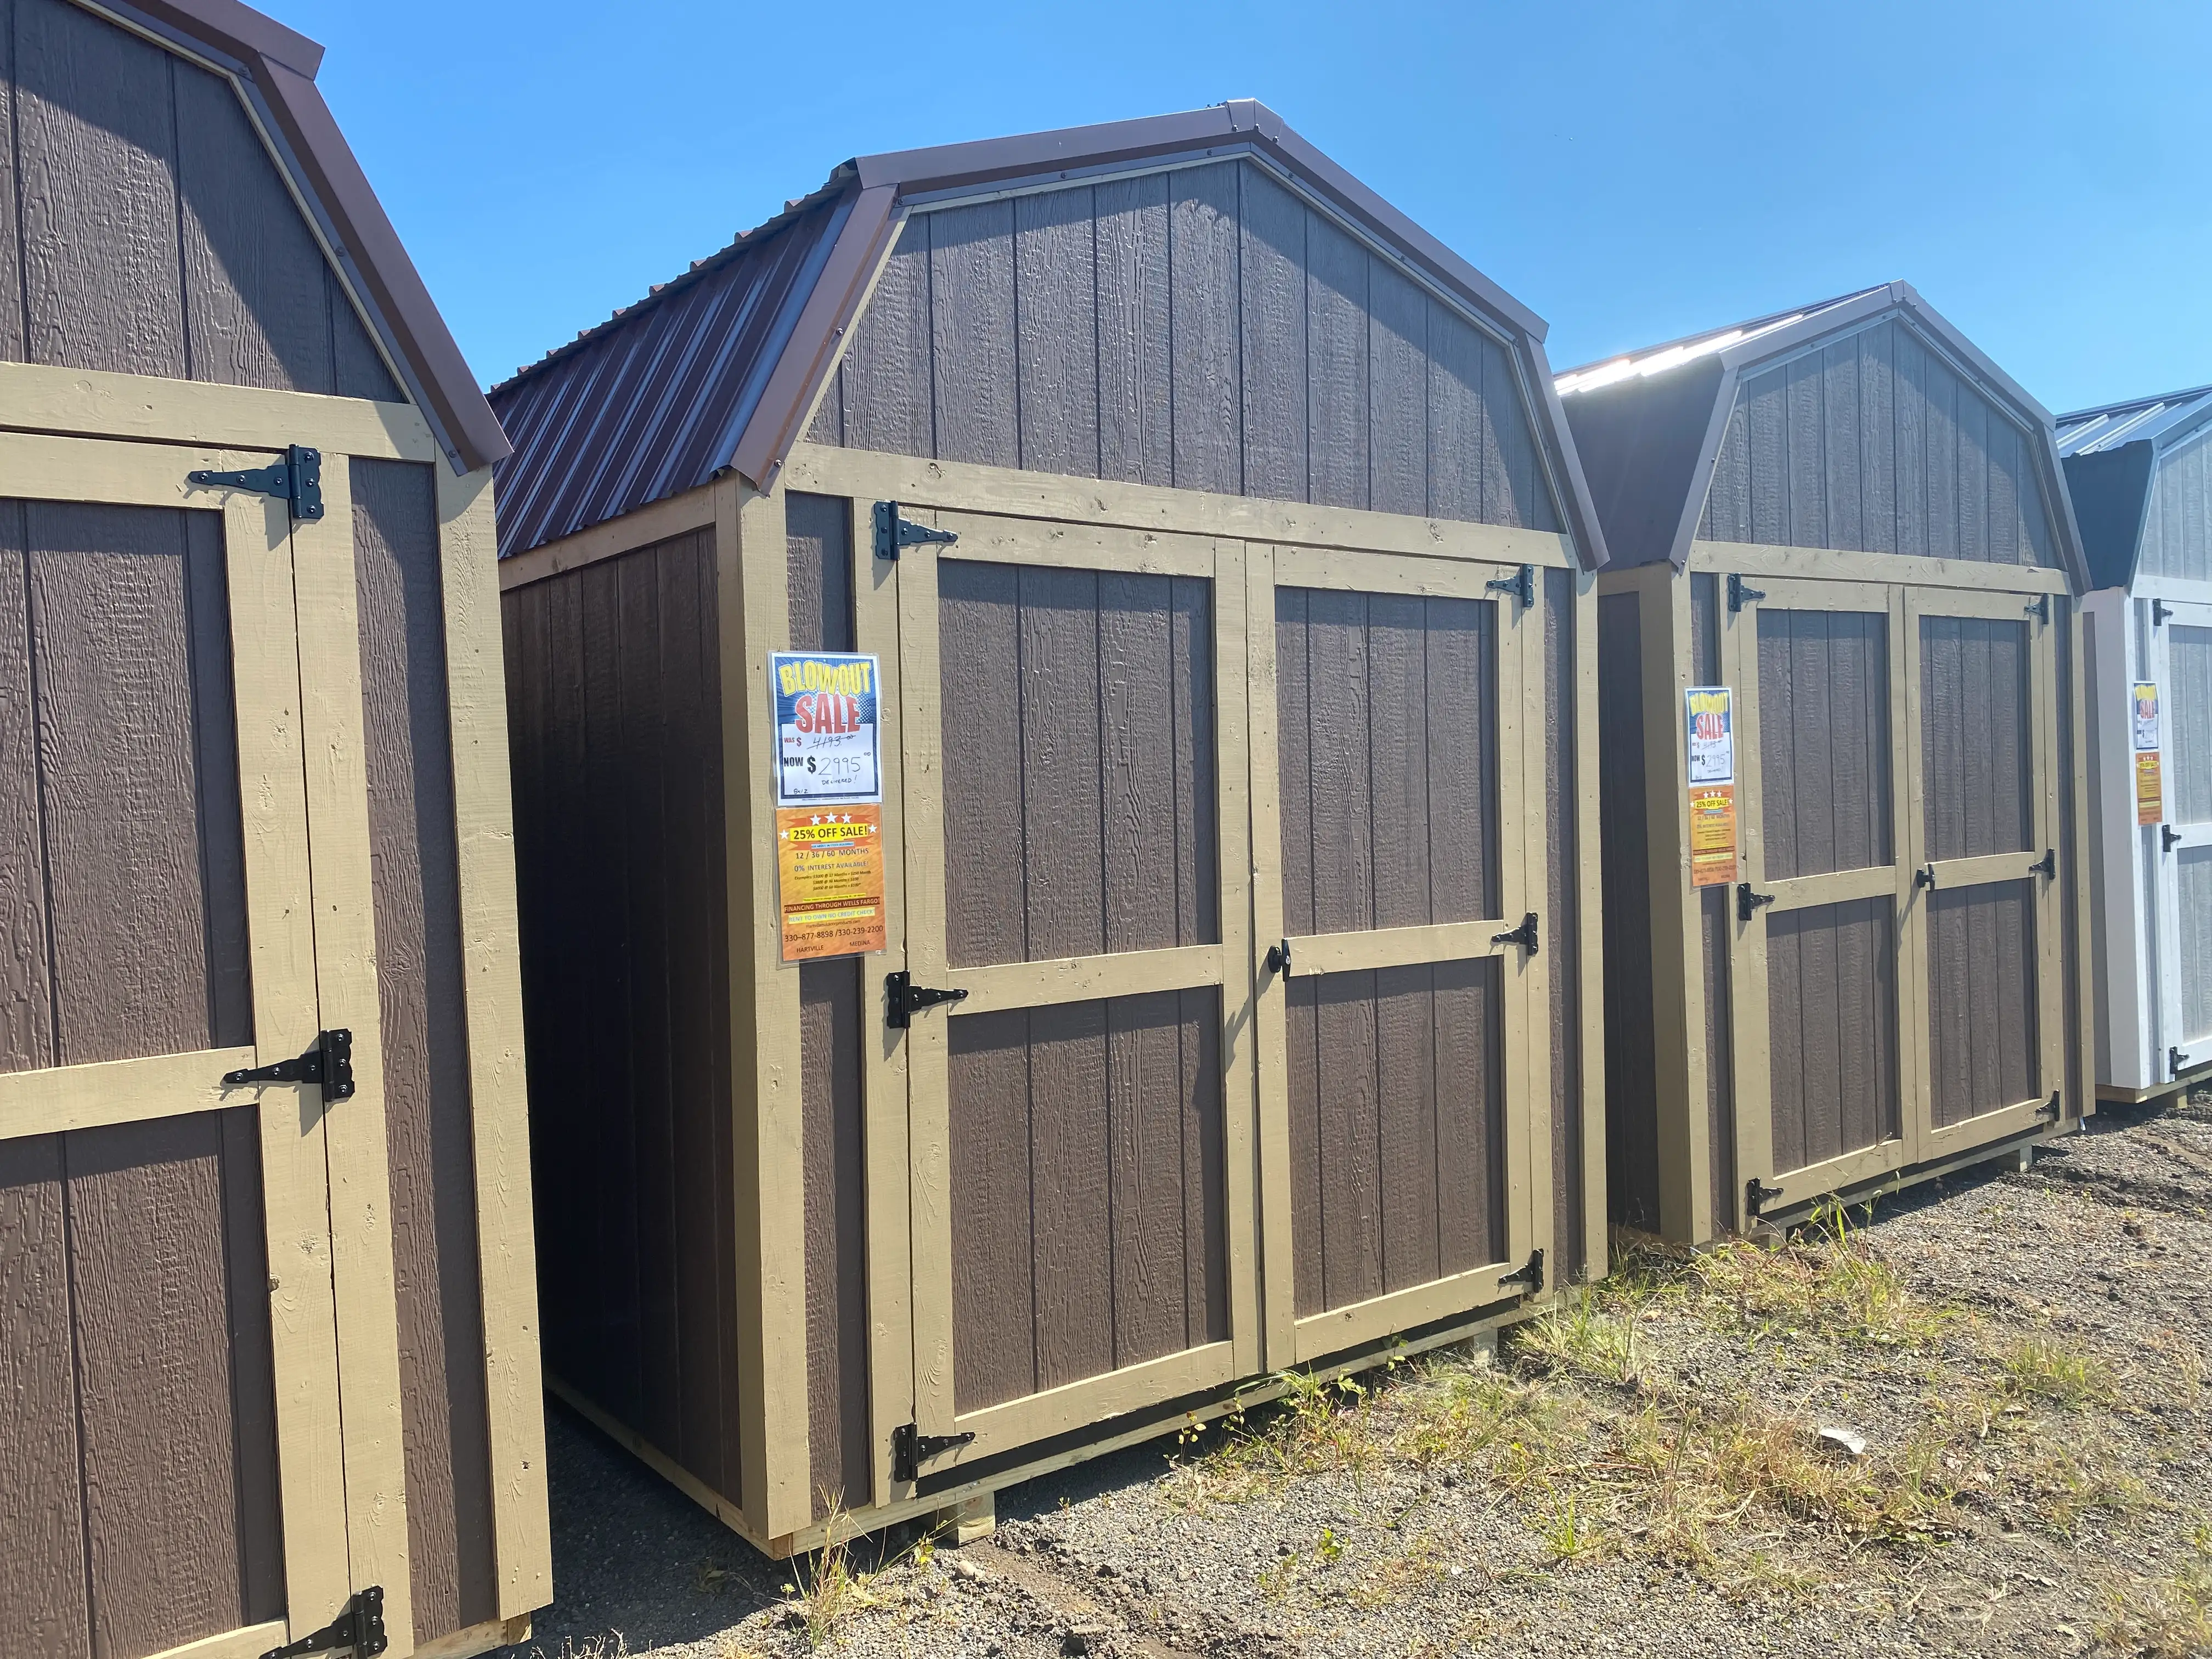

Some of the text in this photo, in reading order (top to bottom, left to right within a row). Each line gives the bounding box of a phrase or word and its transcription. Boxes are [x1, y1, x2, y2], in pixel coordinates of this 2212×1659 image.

[778, 661, 871, 697] BLOWOUT
[795, 693, 860, 733] SALE
[2140, 700, 2155, 719] SALE
[1696, 713, 1724, 740] SALE
[797, 737, 802, 747] $
[784, 757, 803, 767] NOW
[807, 755, 816, 774] $
[818, 757, 861, 775] 2995
[1701, 754, 1705, 766] $
[1706, 754, 1725, 767] 2995
[793, 826, 867, 839] 25% OFF SALE!
[839, 848, 869, 856] MONTHS
[784, 904, 814, 912] FINANCING
[797, 945, 824, 953] HARTVILLE
